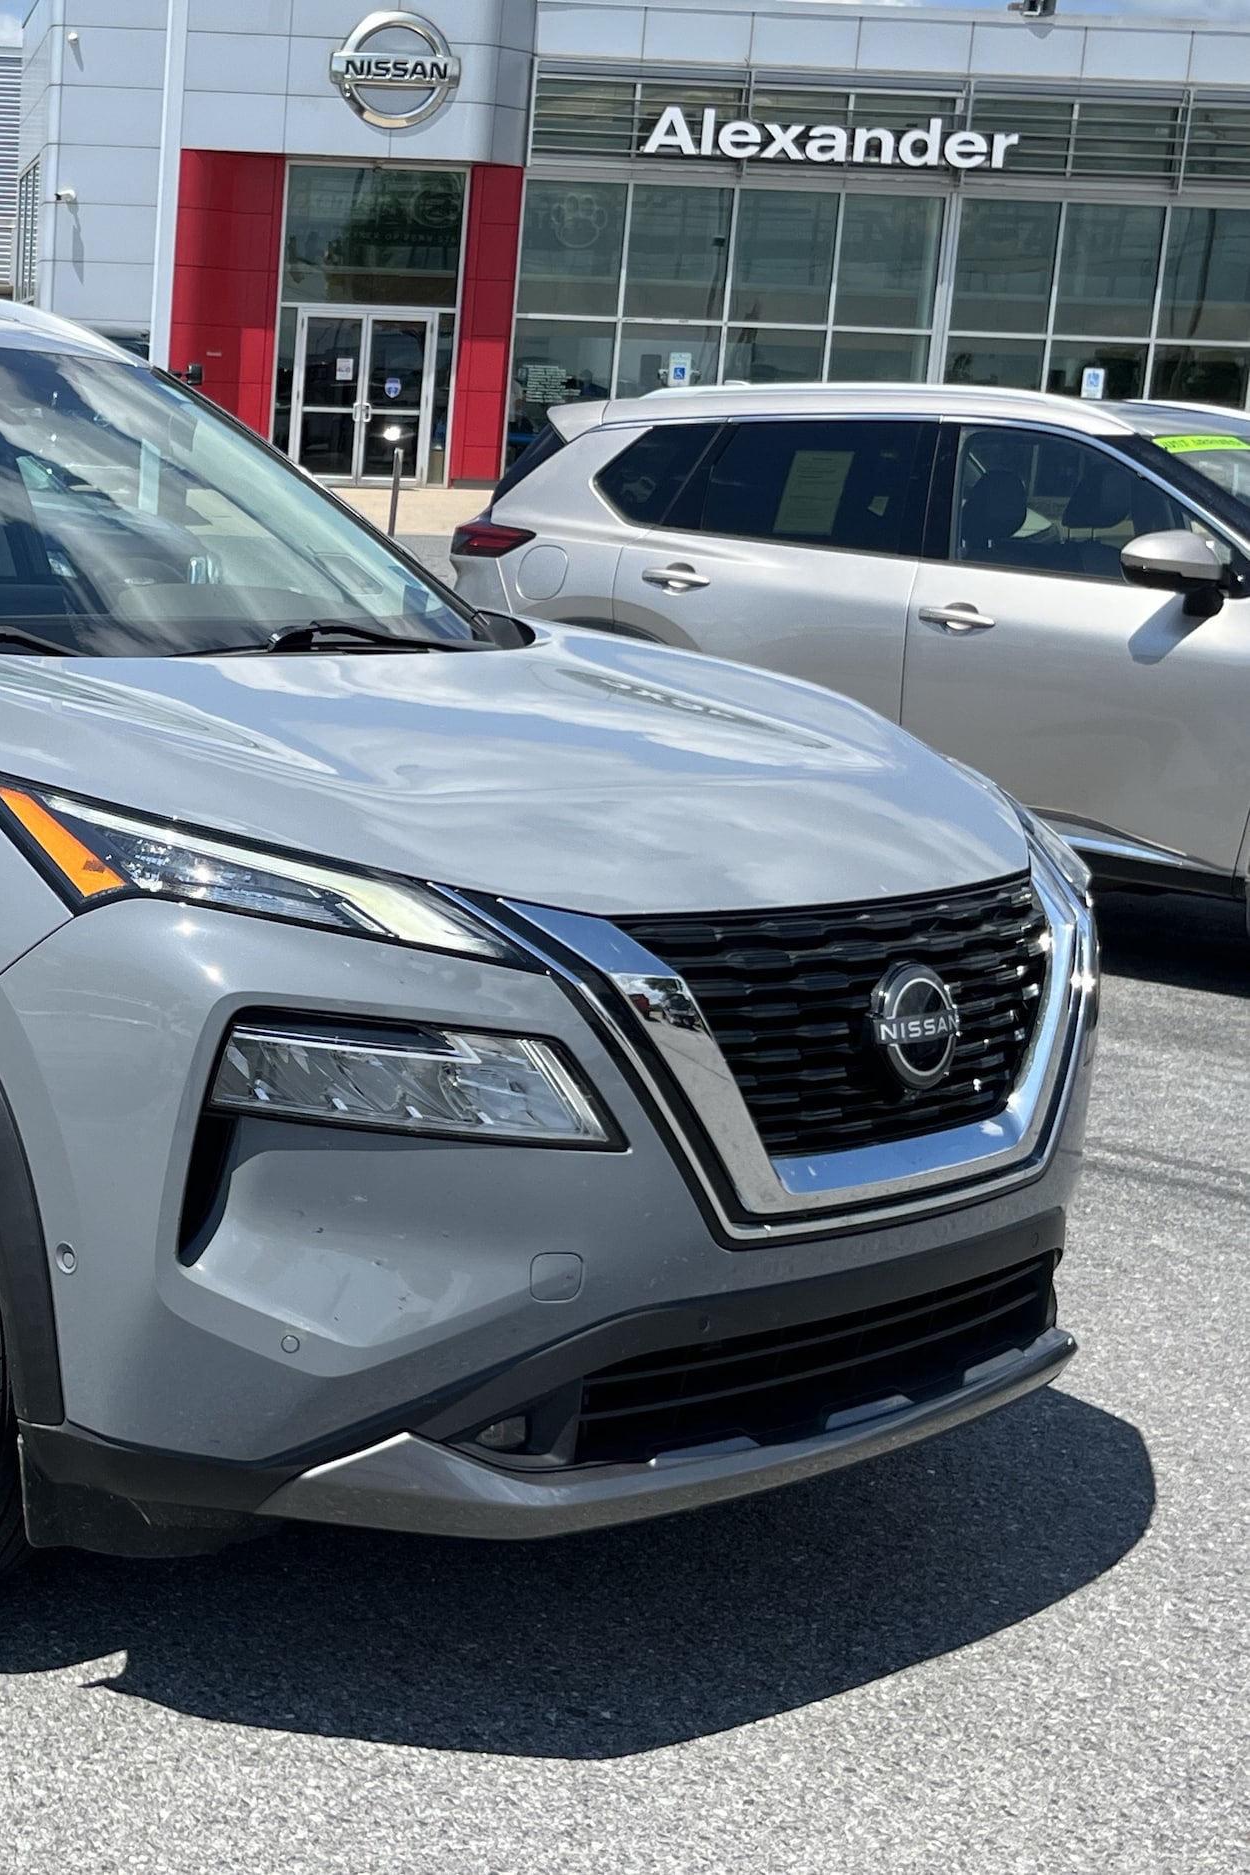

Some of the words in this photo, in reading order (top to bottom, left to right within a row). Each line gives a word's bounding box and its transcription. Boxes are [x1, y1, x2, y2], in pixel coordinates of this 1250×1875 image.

[344, 60, 449, 81] NISSAN
[640, 106, 1020, 169] Alexander
[879, 1014, 959, 1041] NISSAN
